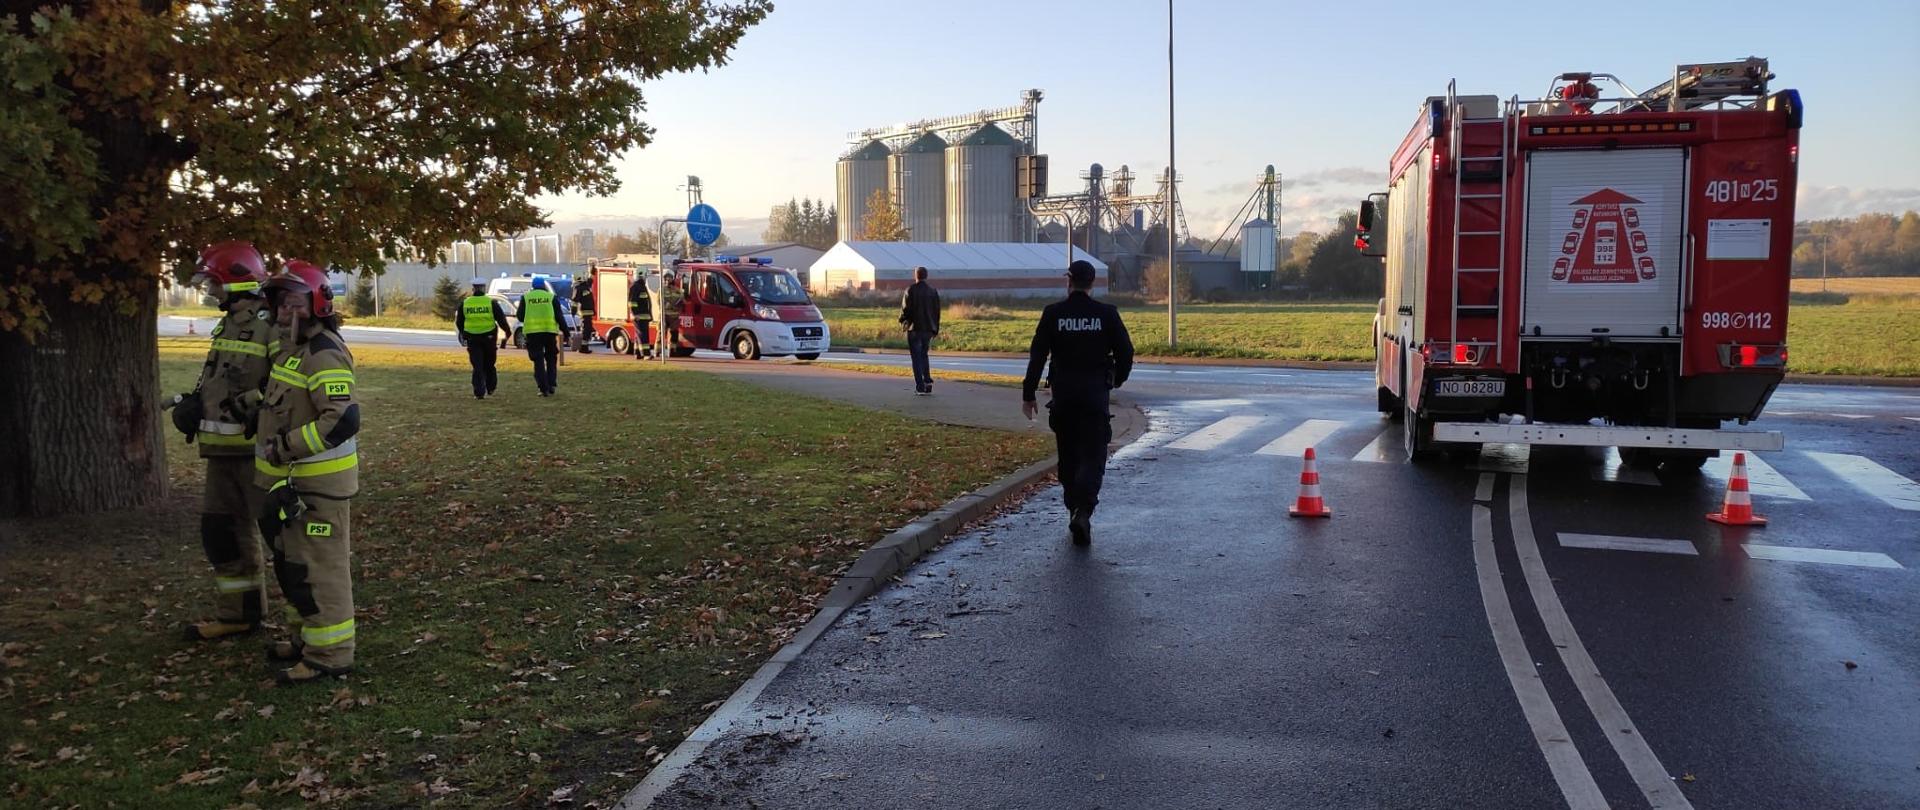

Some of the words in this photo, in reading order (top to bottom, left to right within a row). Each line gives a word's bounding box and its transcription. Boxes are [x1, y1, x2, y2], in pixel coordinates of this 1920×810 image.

[1596, 254, 1614, 262] 112
[466, 306, 490, 314] POLICJA
[1058, 317, 1102, 331] POLICJA
[1702, 311, 1730, 329] 998
[1746, 311, 1772, 329] 112
[329, 384, 346, 393] PSP
[1442, 382, 1459, 394] NO
[1463, 382, 1502, 394] 0828U
[310, 525, 328, 534] PSP
